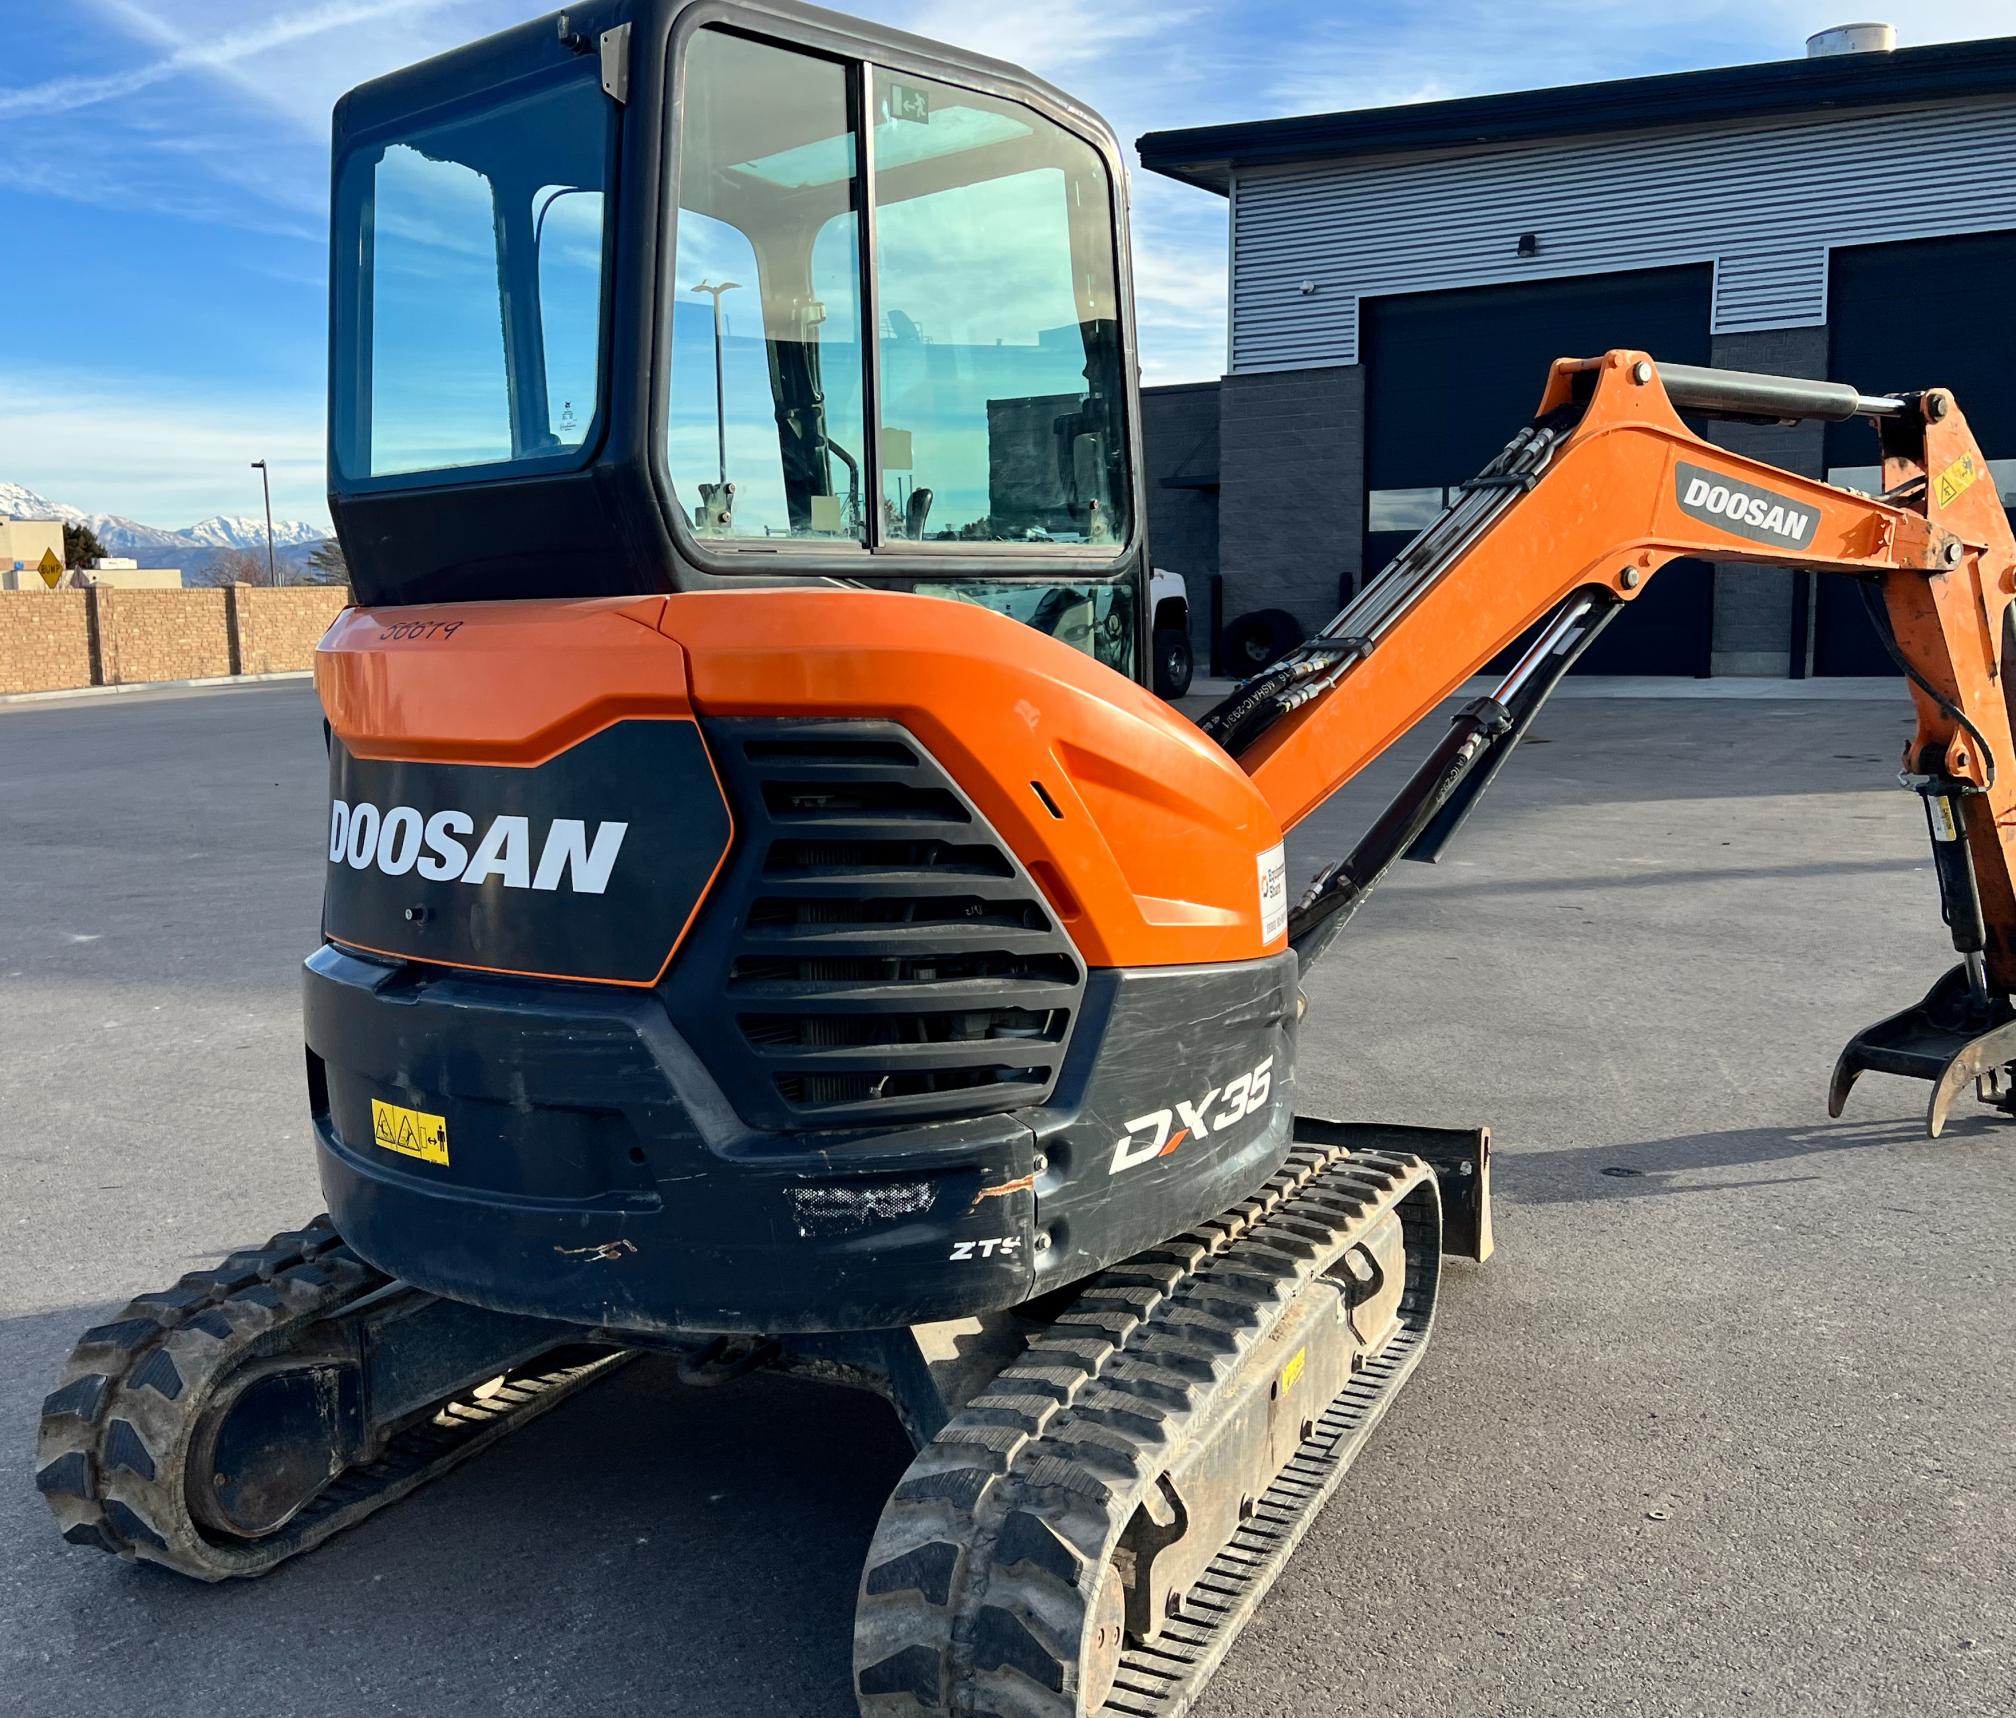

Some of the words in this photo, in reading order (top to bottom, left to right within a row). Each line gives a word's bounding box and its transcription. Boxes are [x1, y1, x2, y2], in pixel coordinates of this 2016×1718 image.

[1683, 477, 1809, 541] DOOSAN
[40, 563, 60, 575] BUMP
[1252, 679, 1276, 701] MSHA
[329, 798, 629, 895] DOOSAN
[1108, 1054, 1274, 1176] DX35
